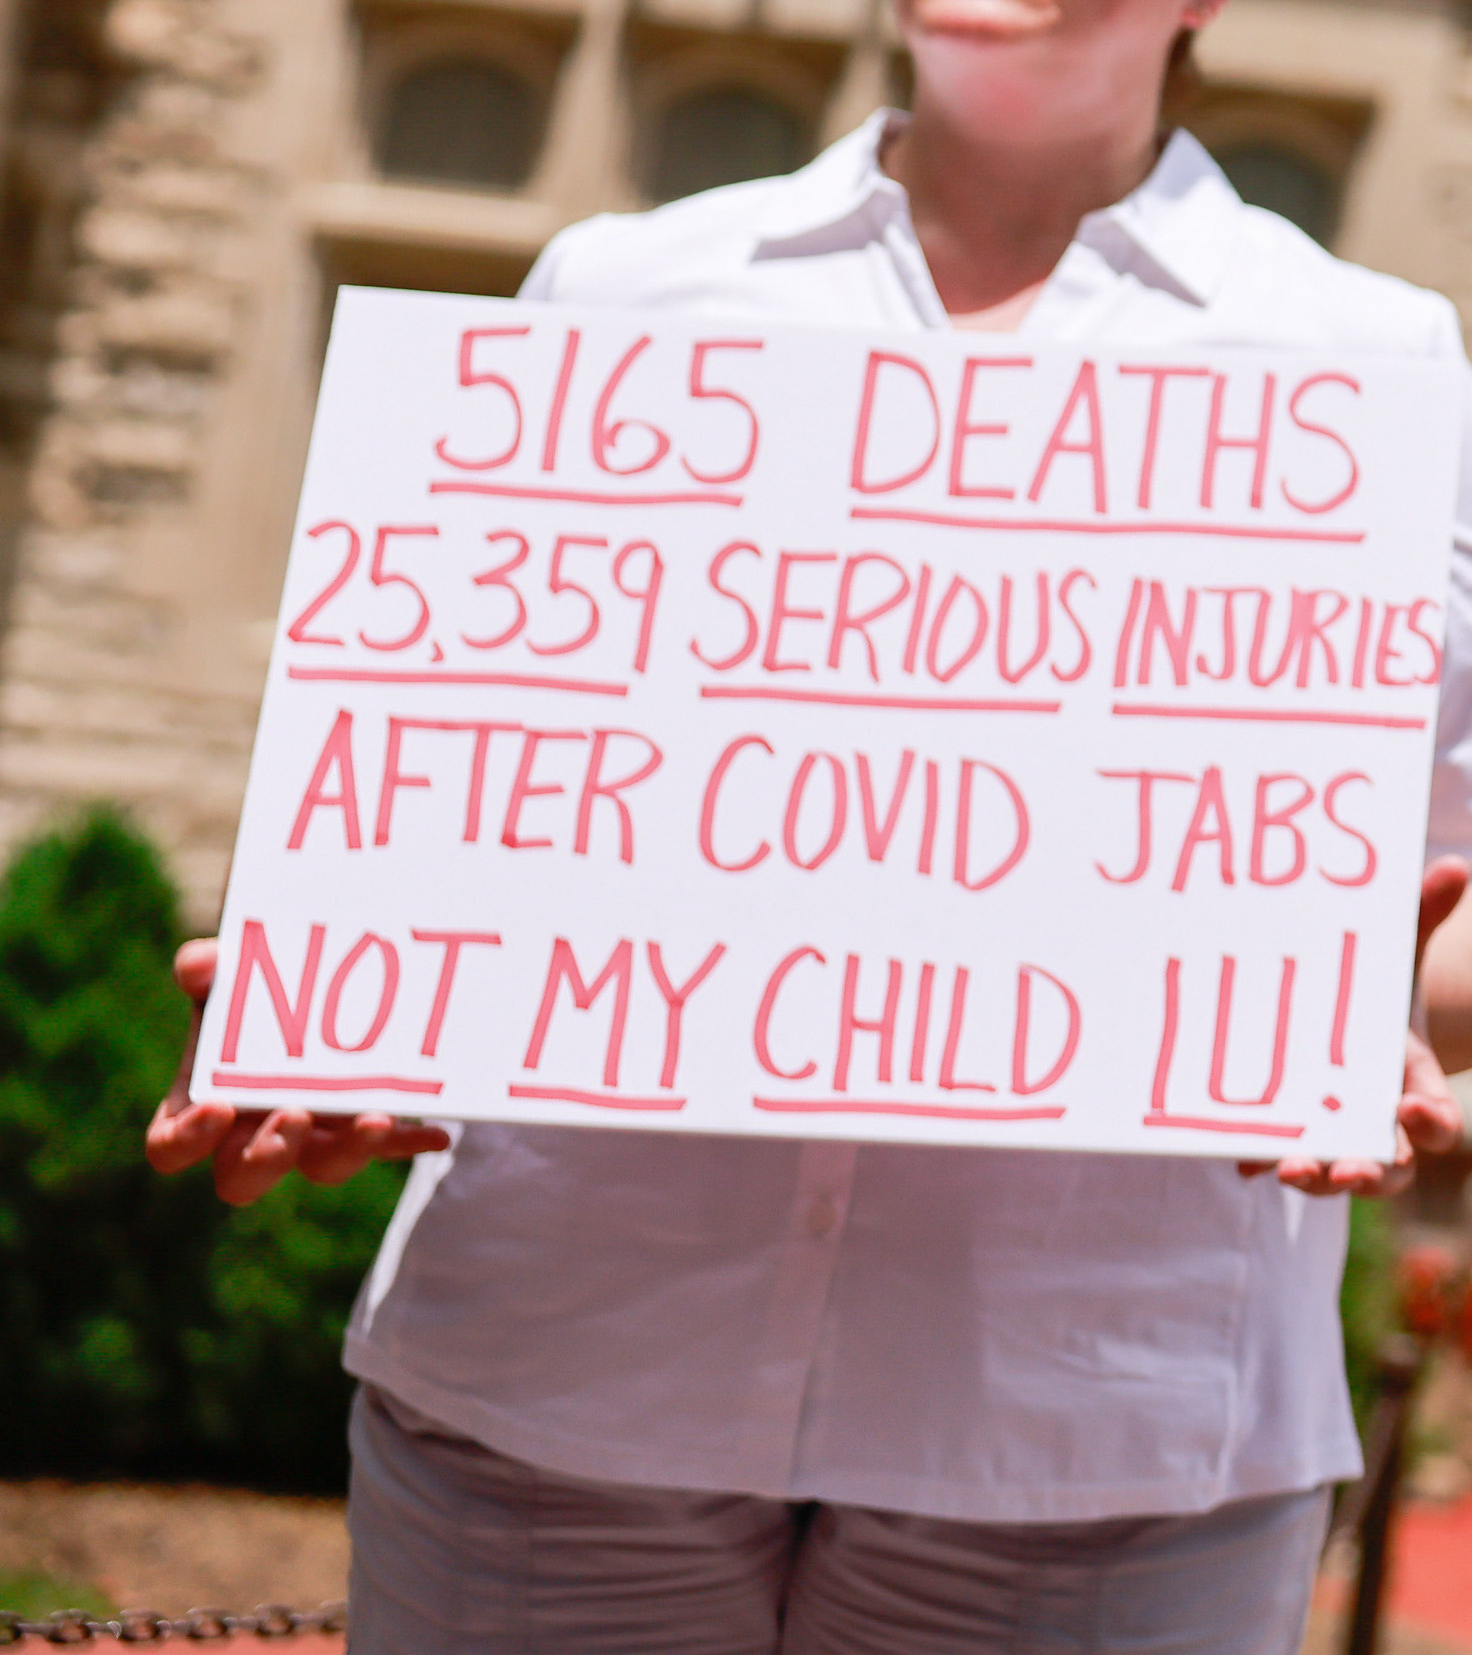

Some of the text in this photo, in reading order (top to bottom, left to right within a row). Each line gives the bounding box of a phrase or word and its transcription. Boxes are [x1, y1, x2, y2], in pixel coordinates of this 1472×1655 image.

[434, 326, 1363, 516] 5165 DEATHS
[286, 519, 1444, 690] 25,359 SERIOUS INJURIES
[286, 707, 1379, 893] AFTER COVID JABS
[219, 918, 503, 1064] NOT
[522, 936, 728, 1091] MY
[752, 944, 1083, 1097] CHILD
